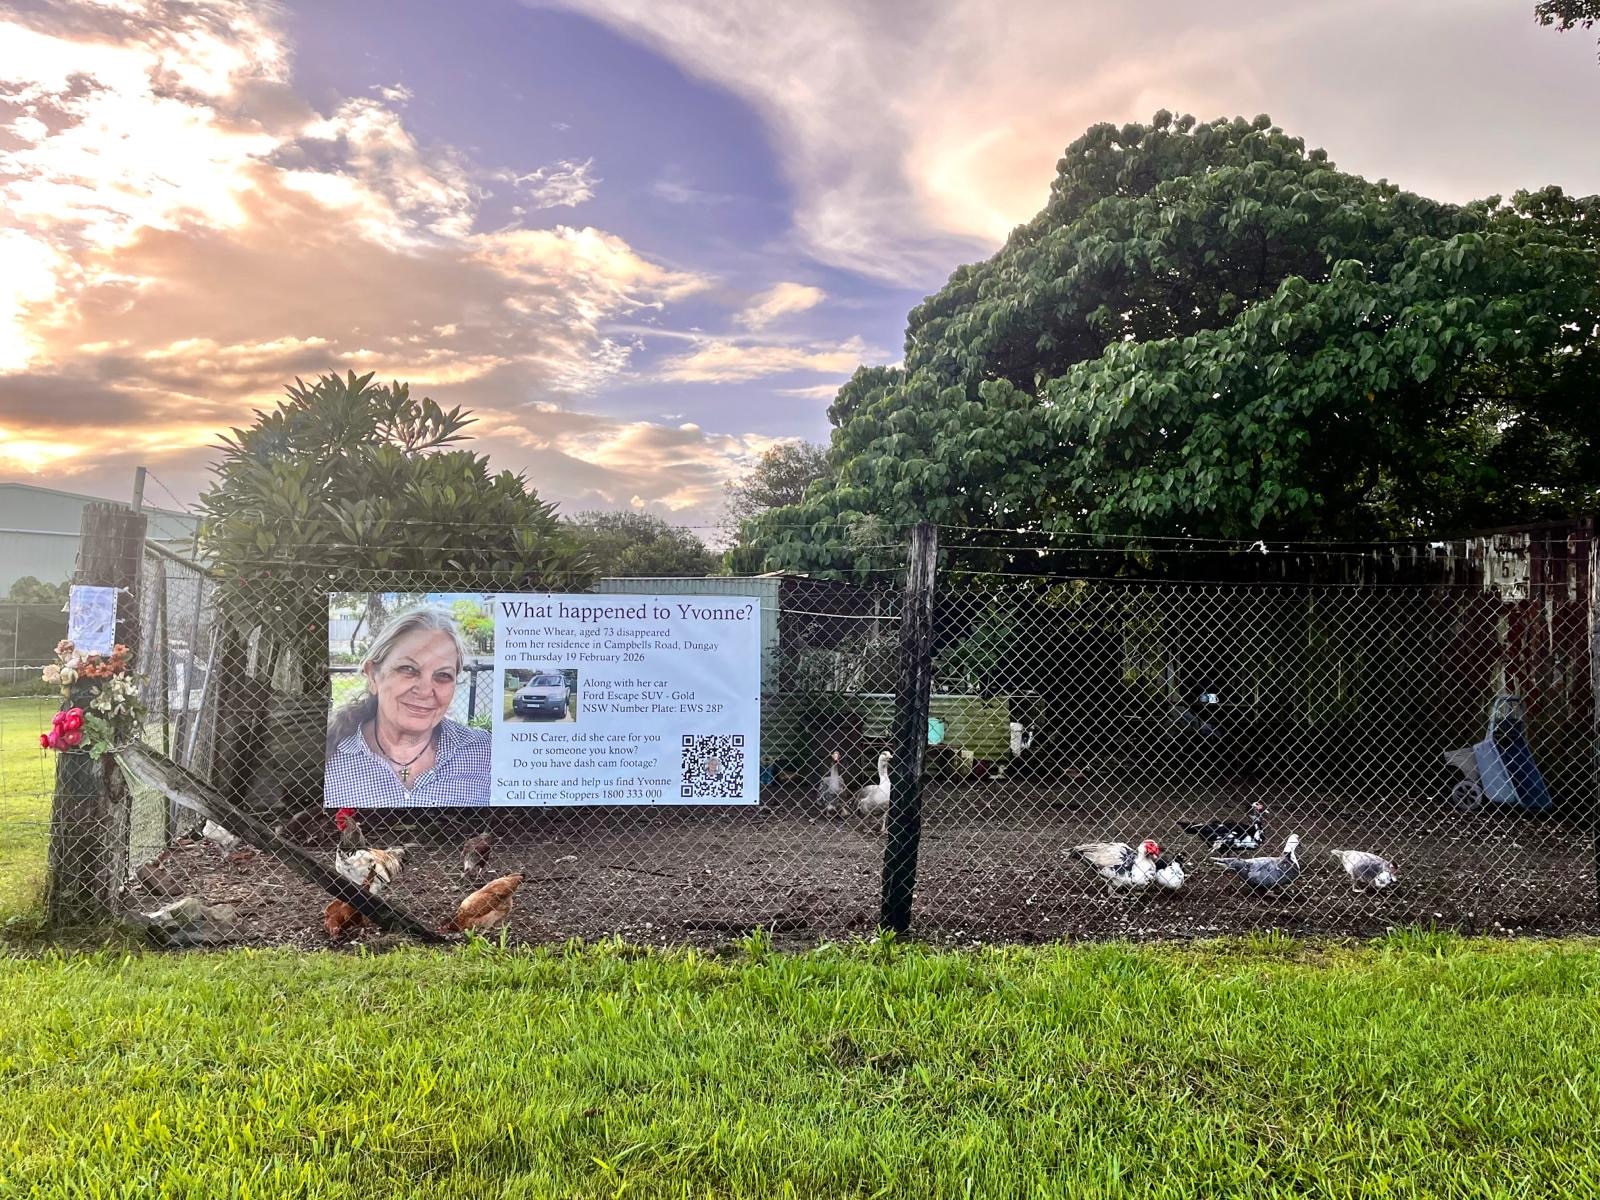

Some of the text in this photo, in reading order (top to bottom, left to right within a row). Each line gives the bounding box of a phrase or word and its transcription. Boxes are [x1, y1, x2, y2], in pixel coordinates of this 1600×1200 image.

[502, 601, 753, 623] What happened to Yvonne?
[505, 626, 671, 639] Yvonne Whear, aged 73 disappeared
[505, 639, 719, 652] from her residence in Campbells Road, Dungay
[504, 651, 646, 664] on Thursday 19 February 2026
[583, 678, 669, 690] Along with her car
[583, 690, 605, 700] Ford
[607, 690, 640, 703] Escape
[641, 690, 664, 700] SUV
[671, 691, 695, 701] Gold
[582, 703, 724, 713] NSW Number Plate: EWS 28P
[510, 732, 661, 744] NDIS Carer, did she care for you
[532, 745, 639, 757] or someone you know?
[513, 758, 658, 770] Do you have dash cam footage?
[496, 777, 672, 789] Scan to share and help us find Yvonne
[506, 789, 663, 802] Call Crime Stoppers 1800 333 000
